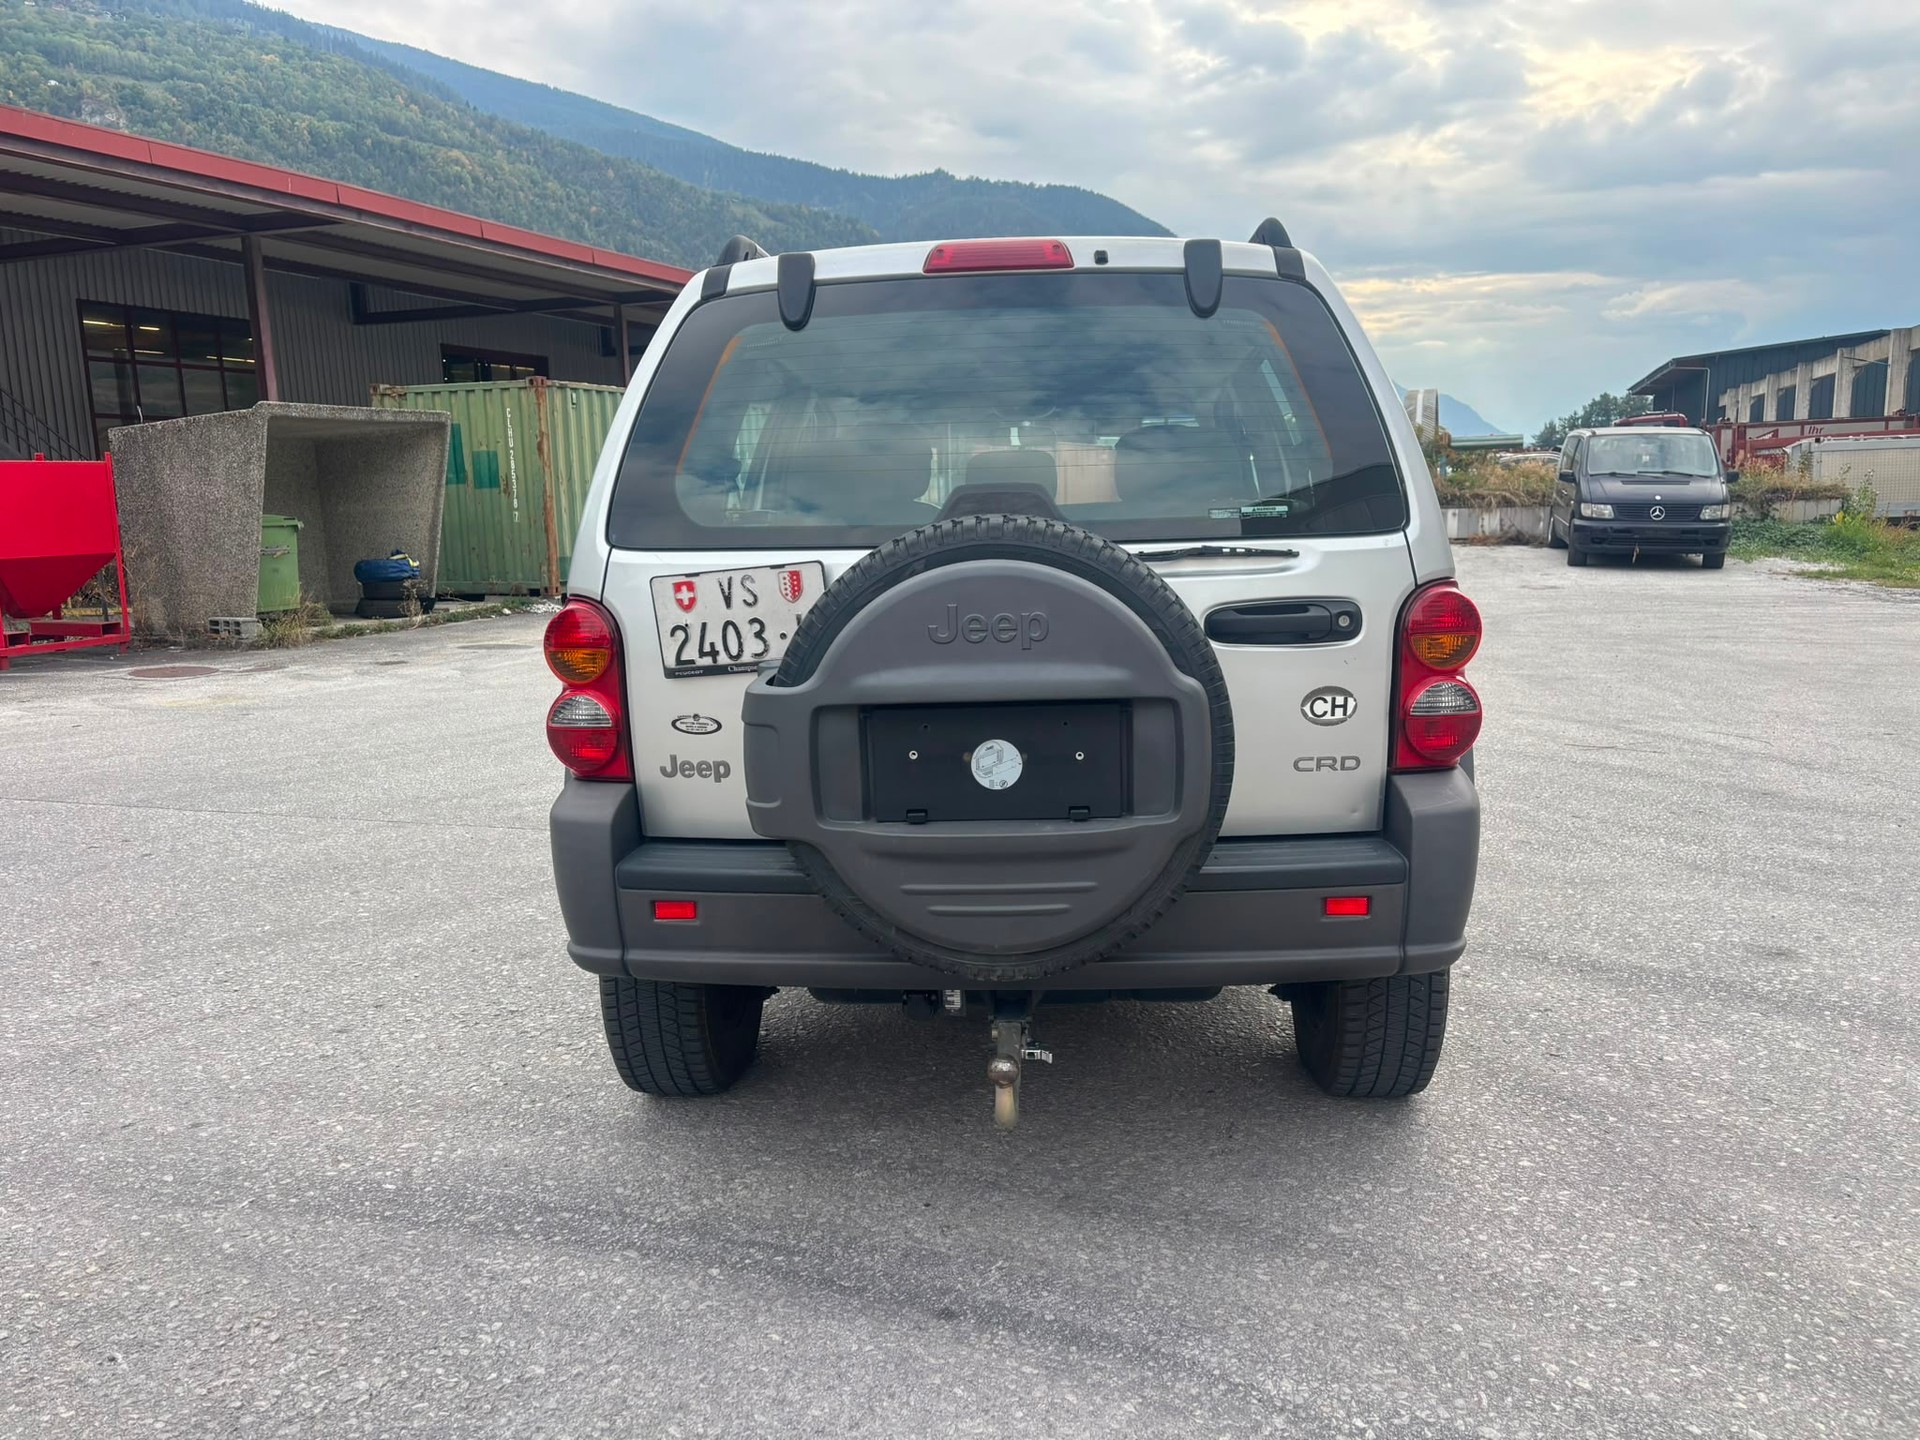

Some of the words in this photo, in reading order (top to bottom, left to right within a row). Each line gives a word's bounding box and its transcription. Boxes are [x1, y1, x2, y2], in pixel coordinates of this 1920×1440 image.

[506, 407, 514, 447] CLHU
[509, 449, 518, 508] 285378
[718, 574, 758, 609] VS
[669, 613, 802, 667] 2403
[927, 603, 1050, 651] Jeep
[1309, 696, 1348, 718] CH
[659, 754, 731, 783] Jeep
[1292, 755, 1361, 772] CRD
